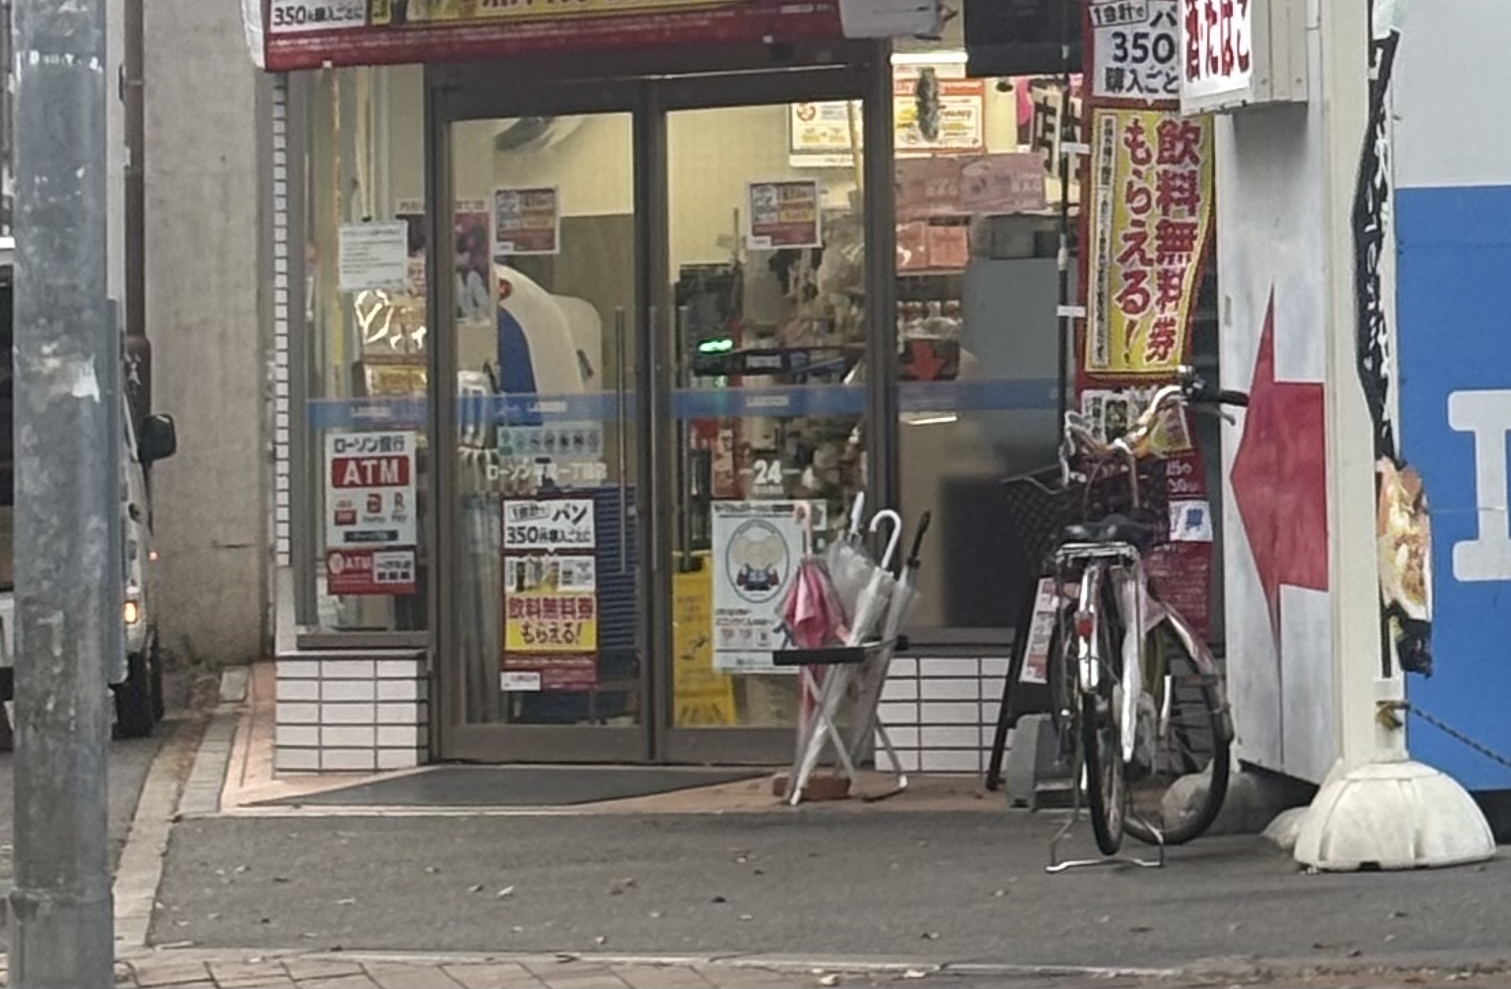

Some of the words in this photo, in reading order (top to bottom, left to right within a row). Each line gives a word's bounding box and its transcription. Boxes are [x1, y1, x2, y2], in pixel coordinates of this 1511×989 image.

[1149, 4, 1178, 28] パ
[1111, 31, 1175, 65] 350
[1104, 65, 1180, 95] 購入ごと
[1114, 118, 1154, 364] もらえる!
[342, 458, 400, 486] ATM
[753, 459, 783, 485] 24
[551, 502, 588, 526] パン
